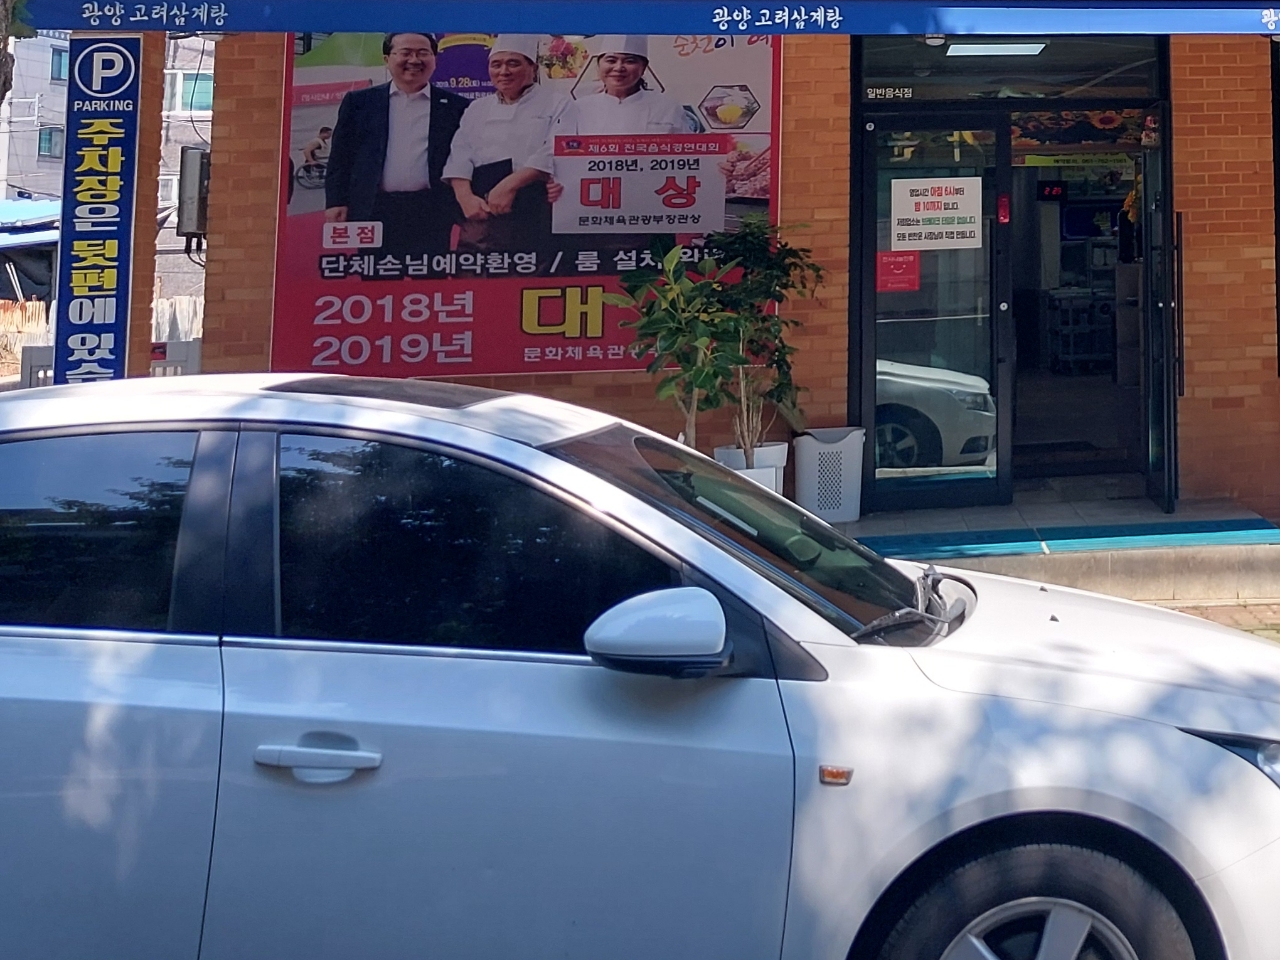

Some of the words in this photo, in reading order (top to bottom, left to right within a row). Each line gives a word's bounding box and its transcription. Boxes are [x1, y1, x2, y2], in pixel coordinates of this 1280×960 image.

[82, 2, 124, 26] 광양
[130, 3, 229, 26] 고려삼계탕
[712, 9, 751, 31] 광양
[755, 8, 843, 30] 고려삼계탕
[867, 88, 913, 99] 일반음식점
[74, 100, 133, 112] PARKING
[588, 144, 619, 153] 제6회
[624, 142, 719, 152] 전국음식경연대회
[73, 118, 125, 231] 주차장은
[650, 158, 700, 171] 2019년
[579, 214, 701, 226] 문화체육관광부장관상
[330, 225, 377, 245] 본점
[321, 250, 537, 277] 단체손님예약환영
[68, 240, 119, 324] 뒷편에
[313, 291, 473, 325] 2018년
[311, 331, 473, 366] 2019년
